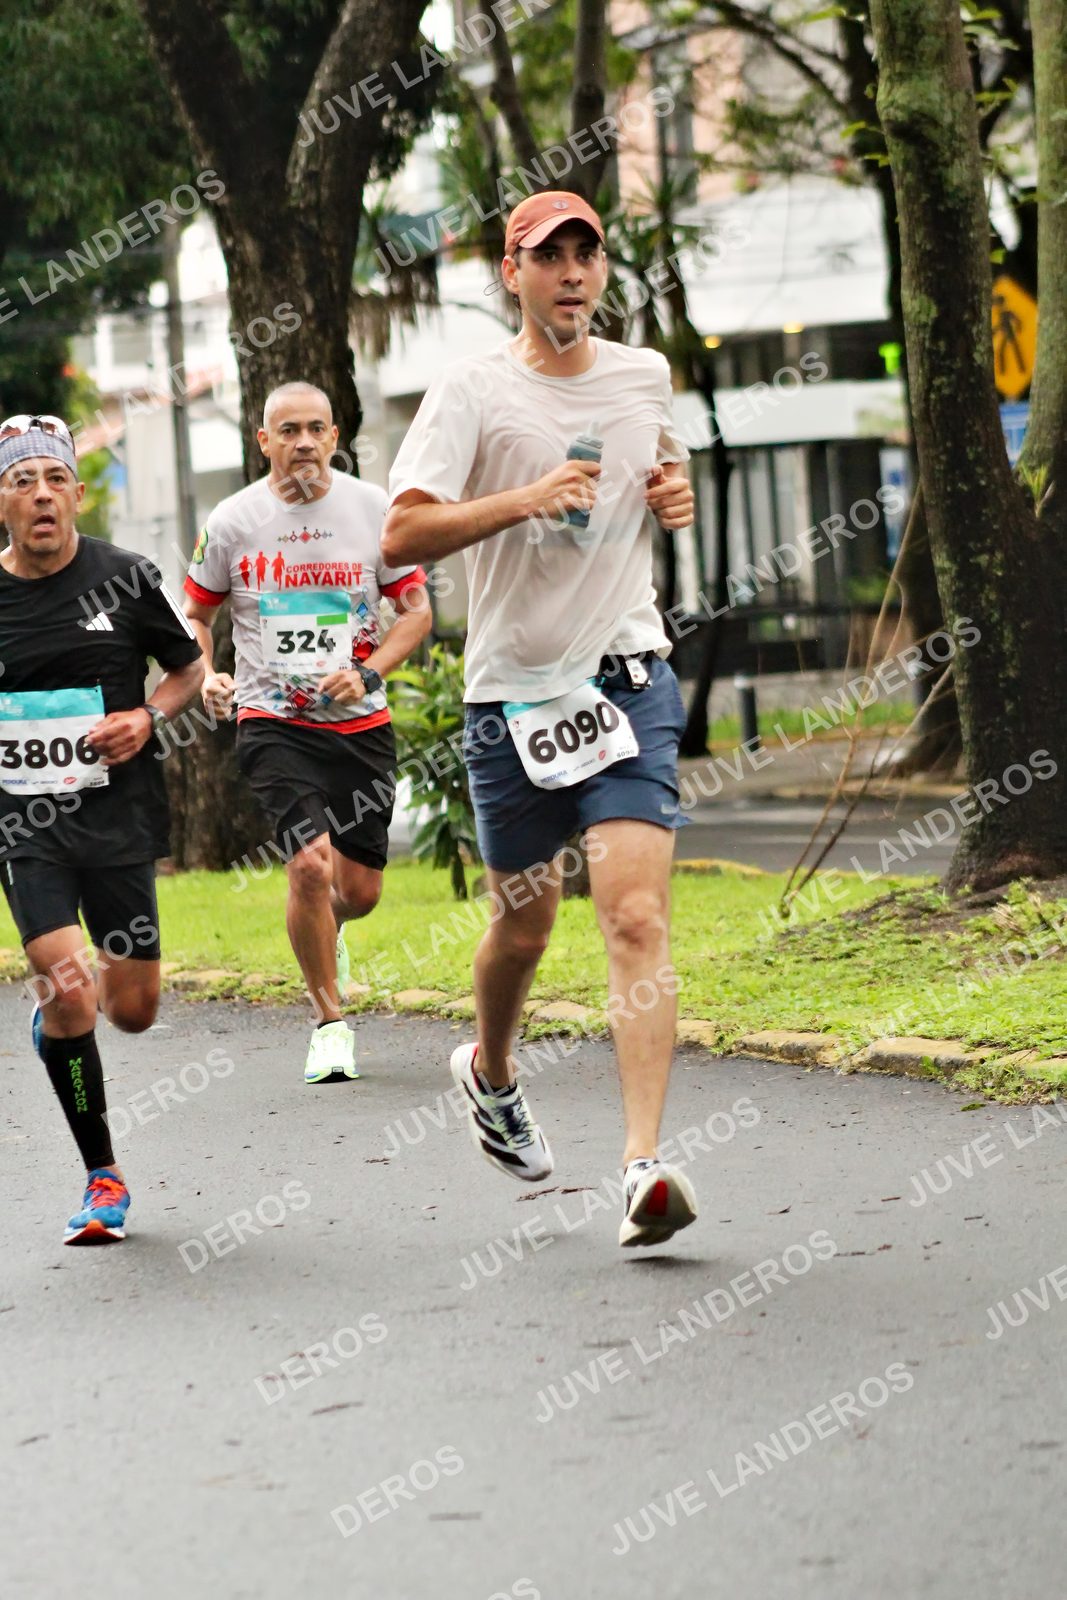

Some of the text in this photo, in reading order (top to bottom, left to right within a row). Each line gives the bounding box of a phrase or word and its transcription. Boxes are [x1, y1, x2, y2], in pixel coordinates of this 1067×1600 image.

[285, 571, 362, 588] NAYARIT
[286, 562, 363, 573] CORREDORES DE
[276, 629, 337, 655] 324
[528, 701, 620, 764] 6090
[0, 734, 101, 769] 3806
[69, 1057, 88, 1113] MARATHON
